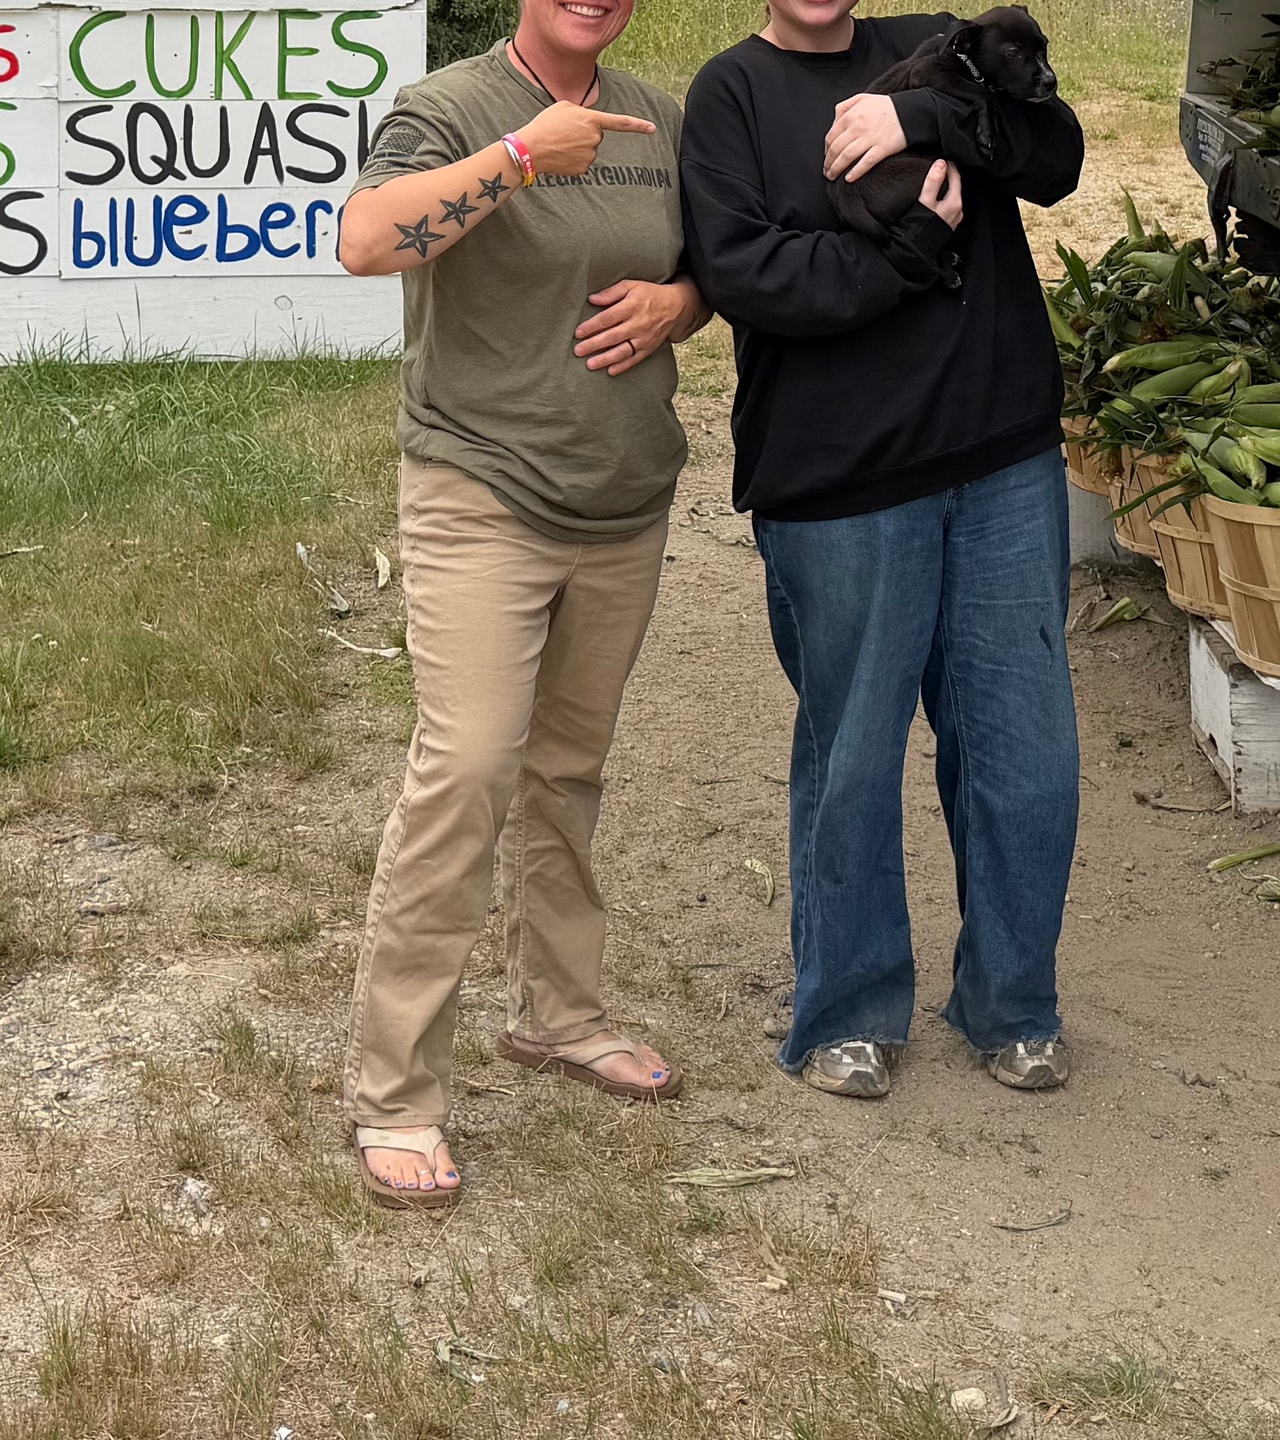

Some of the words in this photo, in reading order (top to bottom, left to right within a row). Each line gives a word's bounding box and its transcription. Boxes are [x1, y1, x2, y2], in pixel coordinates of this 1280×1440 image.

[70, 10, 387, 101] CUKES
[522, 166, 673, 189] LEGACYGUARDIAN
[73, 195, 344, 269] blueber
